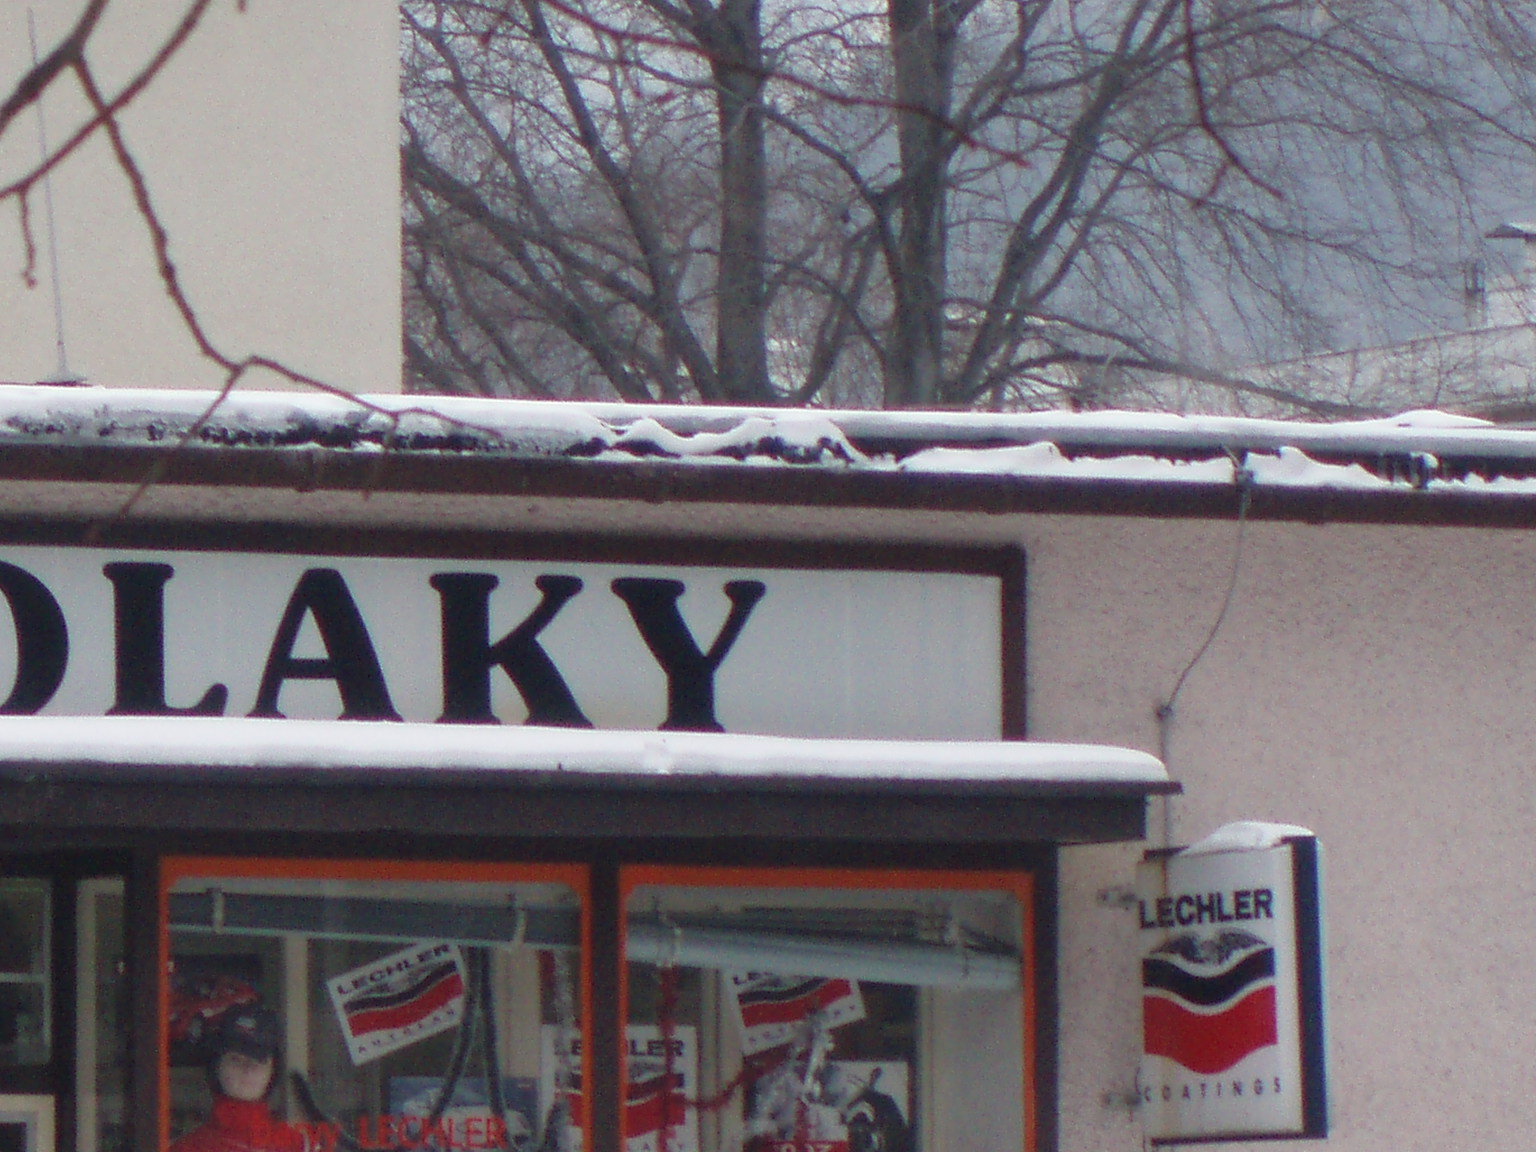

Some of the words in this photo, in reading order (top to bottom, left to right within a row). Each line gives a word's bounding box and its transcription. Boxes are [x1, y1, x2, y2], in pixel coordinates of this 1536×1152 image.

[1137, 888, 1273, 929] LECHLER
[337, 943, 451, 995] LECHLER
[1144, 1076, 1281, 1102] COATINGS
